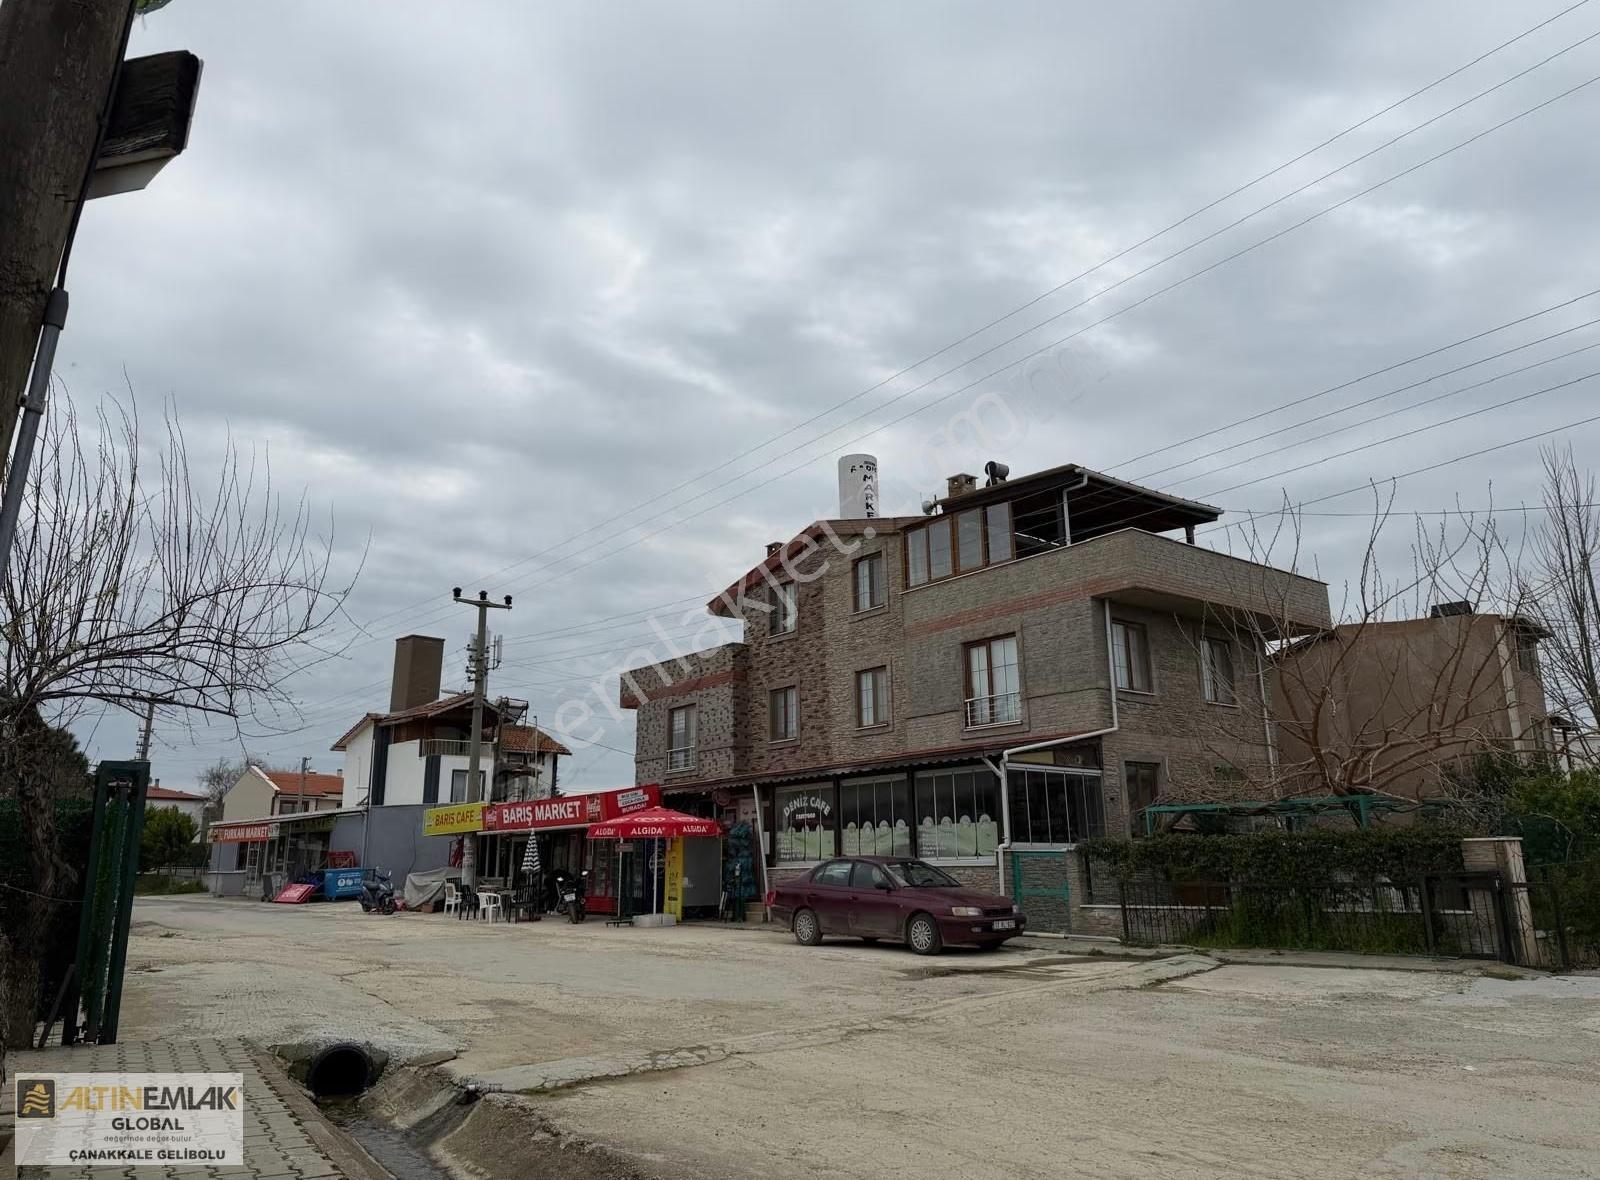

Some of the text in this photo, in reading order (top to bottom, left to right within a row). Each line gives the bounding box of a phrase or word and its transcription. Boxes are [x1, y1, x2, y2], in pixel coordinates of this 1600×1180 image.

[502, 806, 533, 826] BARIŞ
[534, 800, 581, 822] MARKET
[809, 796, 831, 817] CAFE
[456, 810, 475, 824] CAFE
[246, 825, 268, 838] MARKET
[595, 827, 615, 836] ALGIDA
[631, 826, 664, 835] ALGIDA
[682, 824, 707, 833] ALGIDA
